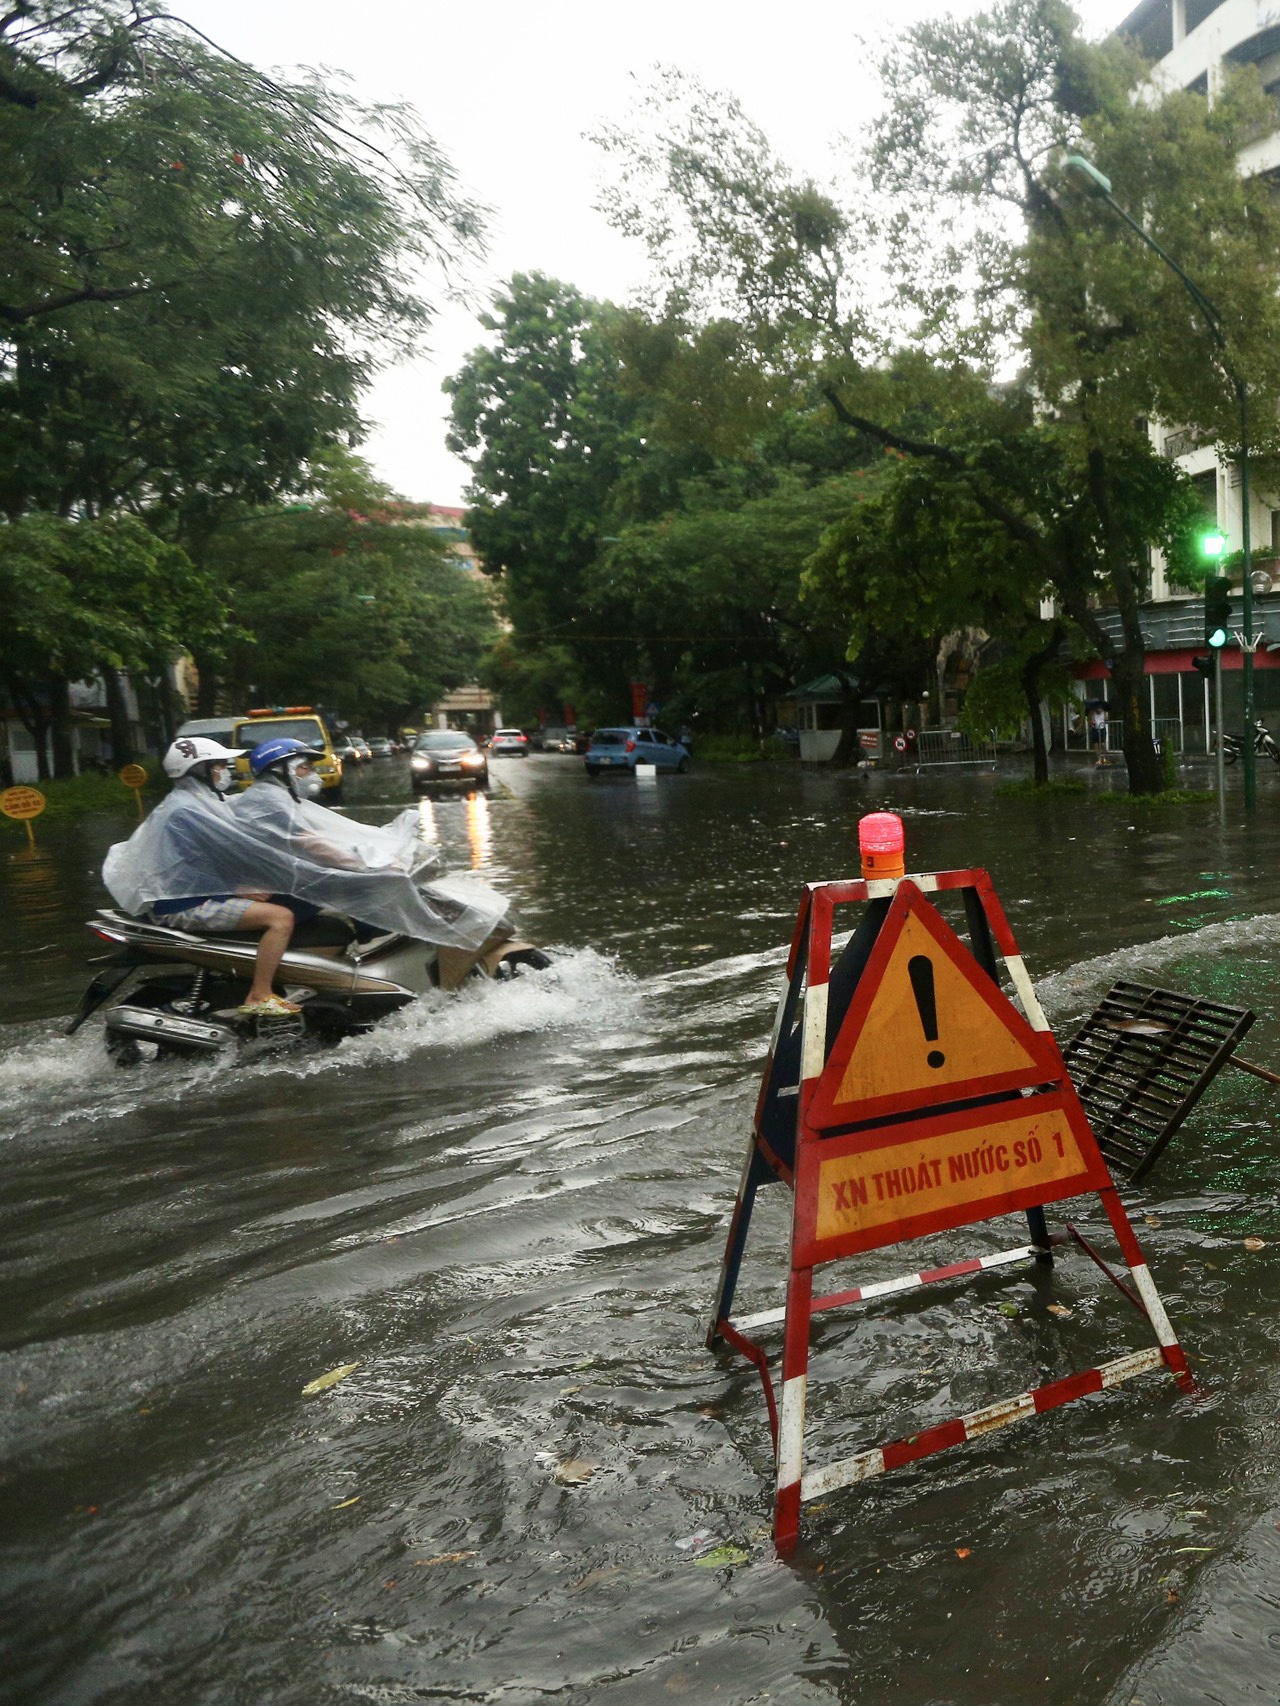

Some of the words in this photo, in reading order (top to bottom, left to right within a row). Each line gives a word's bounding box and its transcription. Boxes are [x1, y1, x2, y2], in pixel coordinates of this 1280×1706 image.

[831, 1174, 868, 1212] XN
[874, 1152, 942, 1201] THOÁT
[947, 1139, 1010, 1184] NƯỚC
[1015, 1125, 1043, 1168] SỐ
[1052, 1131, 1065, 1158] 1
